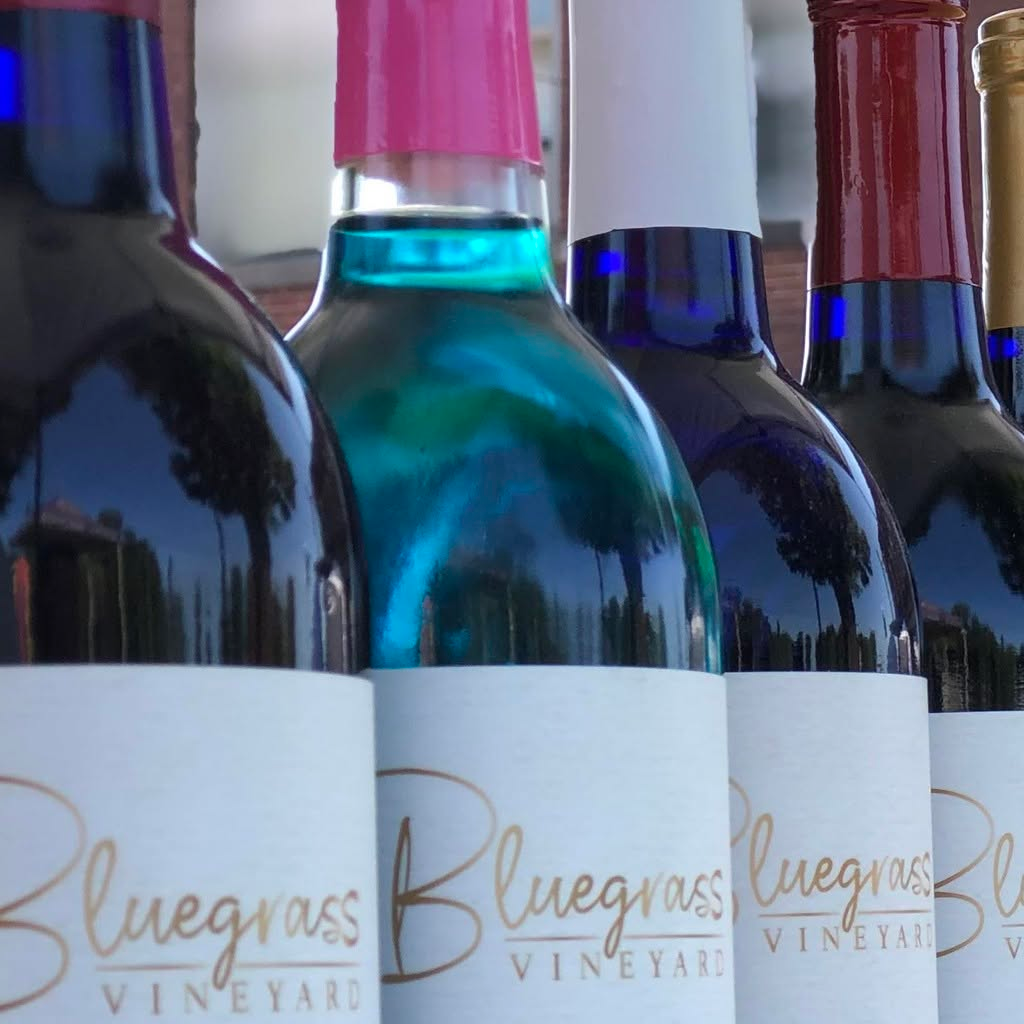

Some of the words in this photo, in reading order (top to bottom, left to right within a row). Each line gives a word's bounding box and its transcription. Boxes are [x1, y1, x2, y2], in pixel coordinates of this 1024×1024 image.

[376, 768, 725, 984] Bluegrass
[729, 777, 931, 932] luegrass
[102, 979, 360, 1015] VINEYARD
[510, 949, 725, 981] VINEYARD
